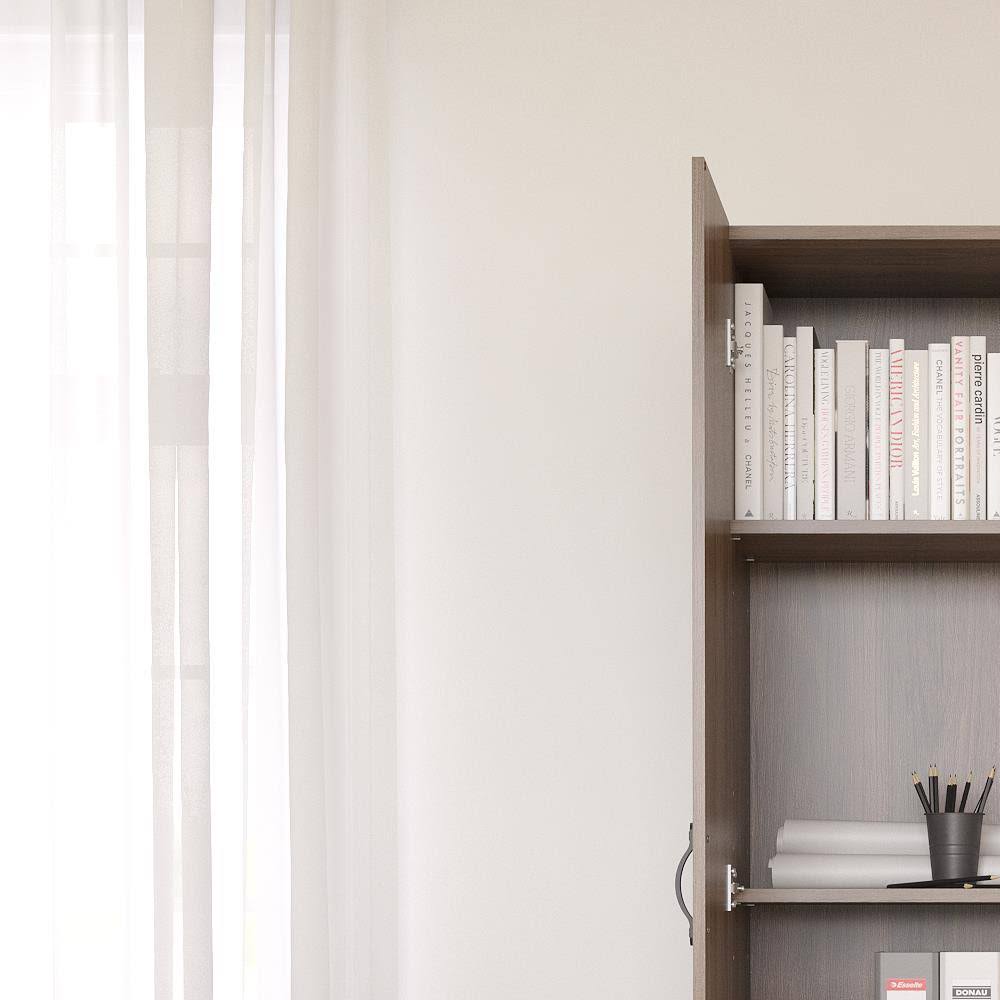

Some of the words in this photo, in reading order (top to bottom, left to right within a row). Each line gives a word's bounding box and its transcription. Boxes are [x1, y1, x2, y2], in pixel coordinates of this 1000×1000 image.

[785, 344, 796, 417] CAROLINA
[954, 341, 964, 386] VANITY
[971, 354, 985, 387] pierre
[891, 350, 903, 425] AMERICAN
[954, 392, 965, 421] FAIR
[974, 390, 985, 424] cardin
[891, 431, 903, 468] DIOR
[955, 427, 966, 506] PORTRAITS
